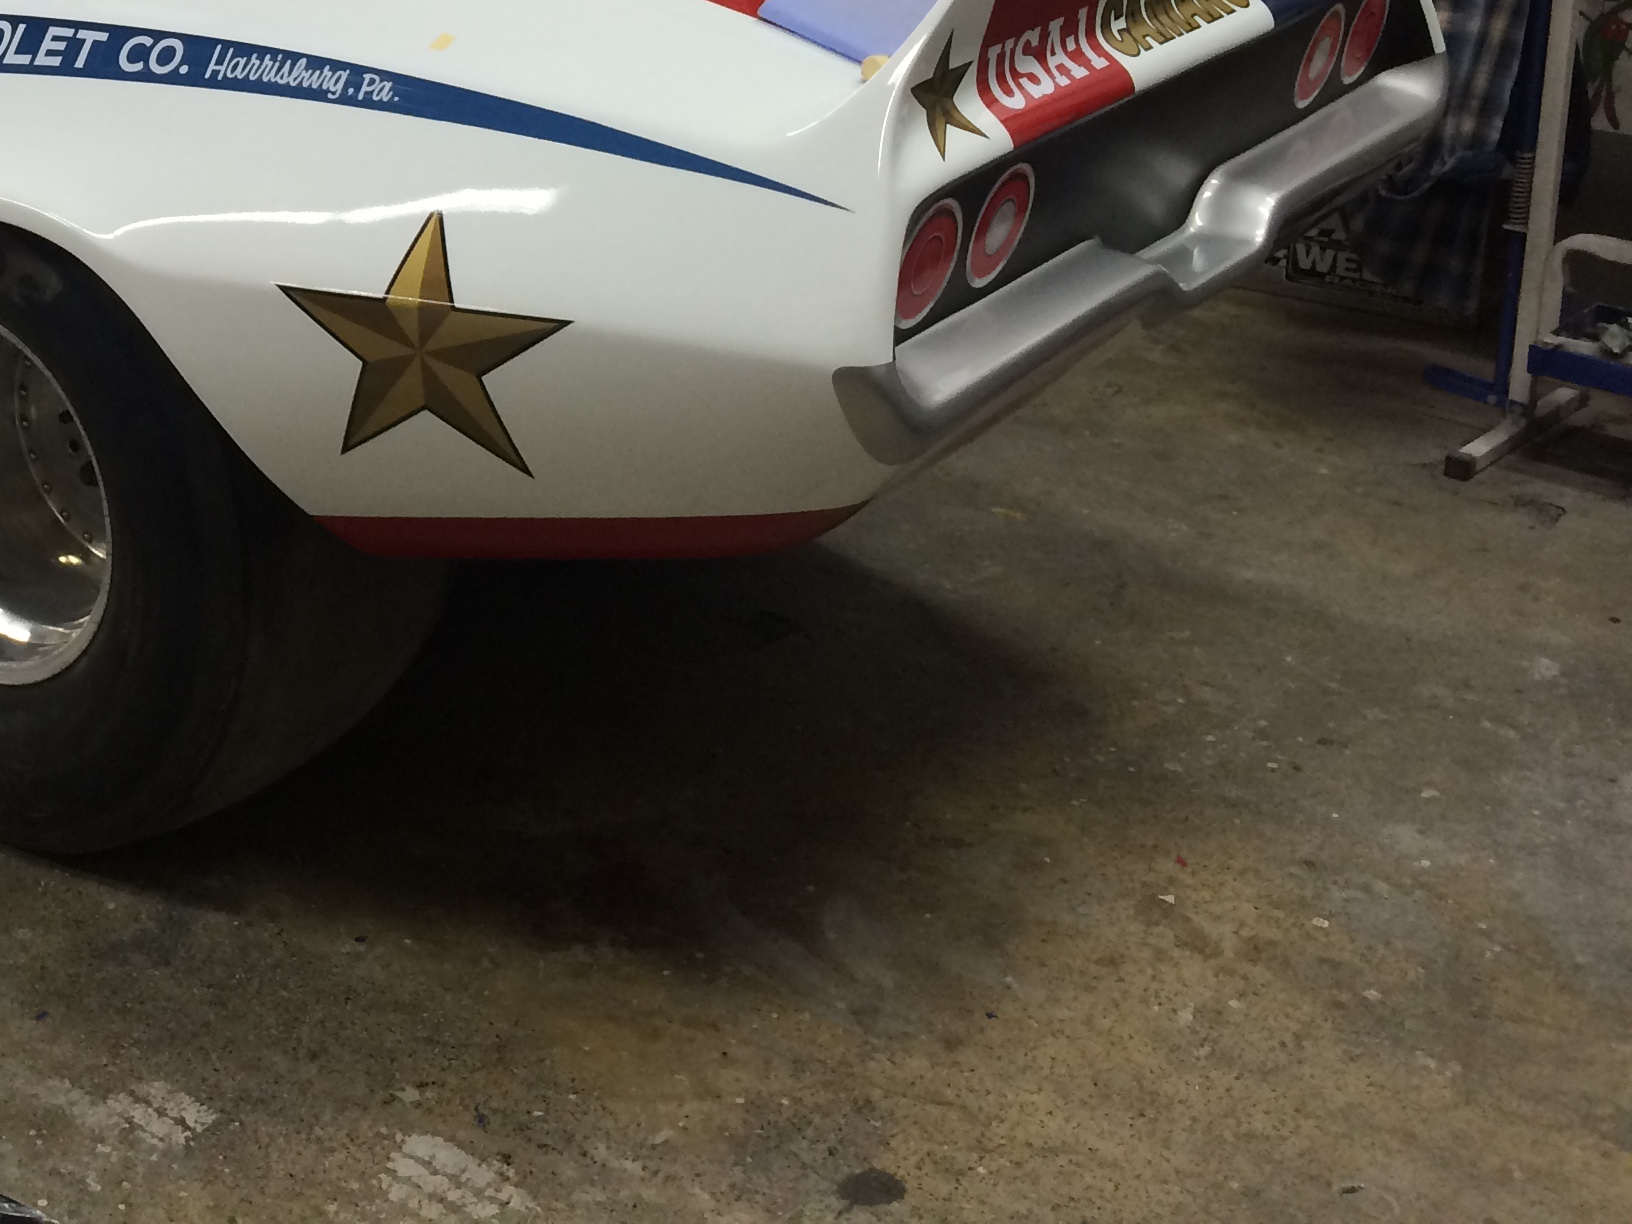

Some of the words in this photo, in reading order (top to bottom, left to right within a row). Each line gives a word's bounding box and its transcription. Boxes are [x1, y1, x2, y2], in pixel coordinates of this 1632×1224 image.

[118, 36, 190, 75] CO.
[204, 44, 356, 100] Harrisburg,
[357, 73, 400, 103] Pa.
[985, 5, 1108, 110] USA-1
